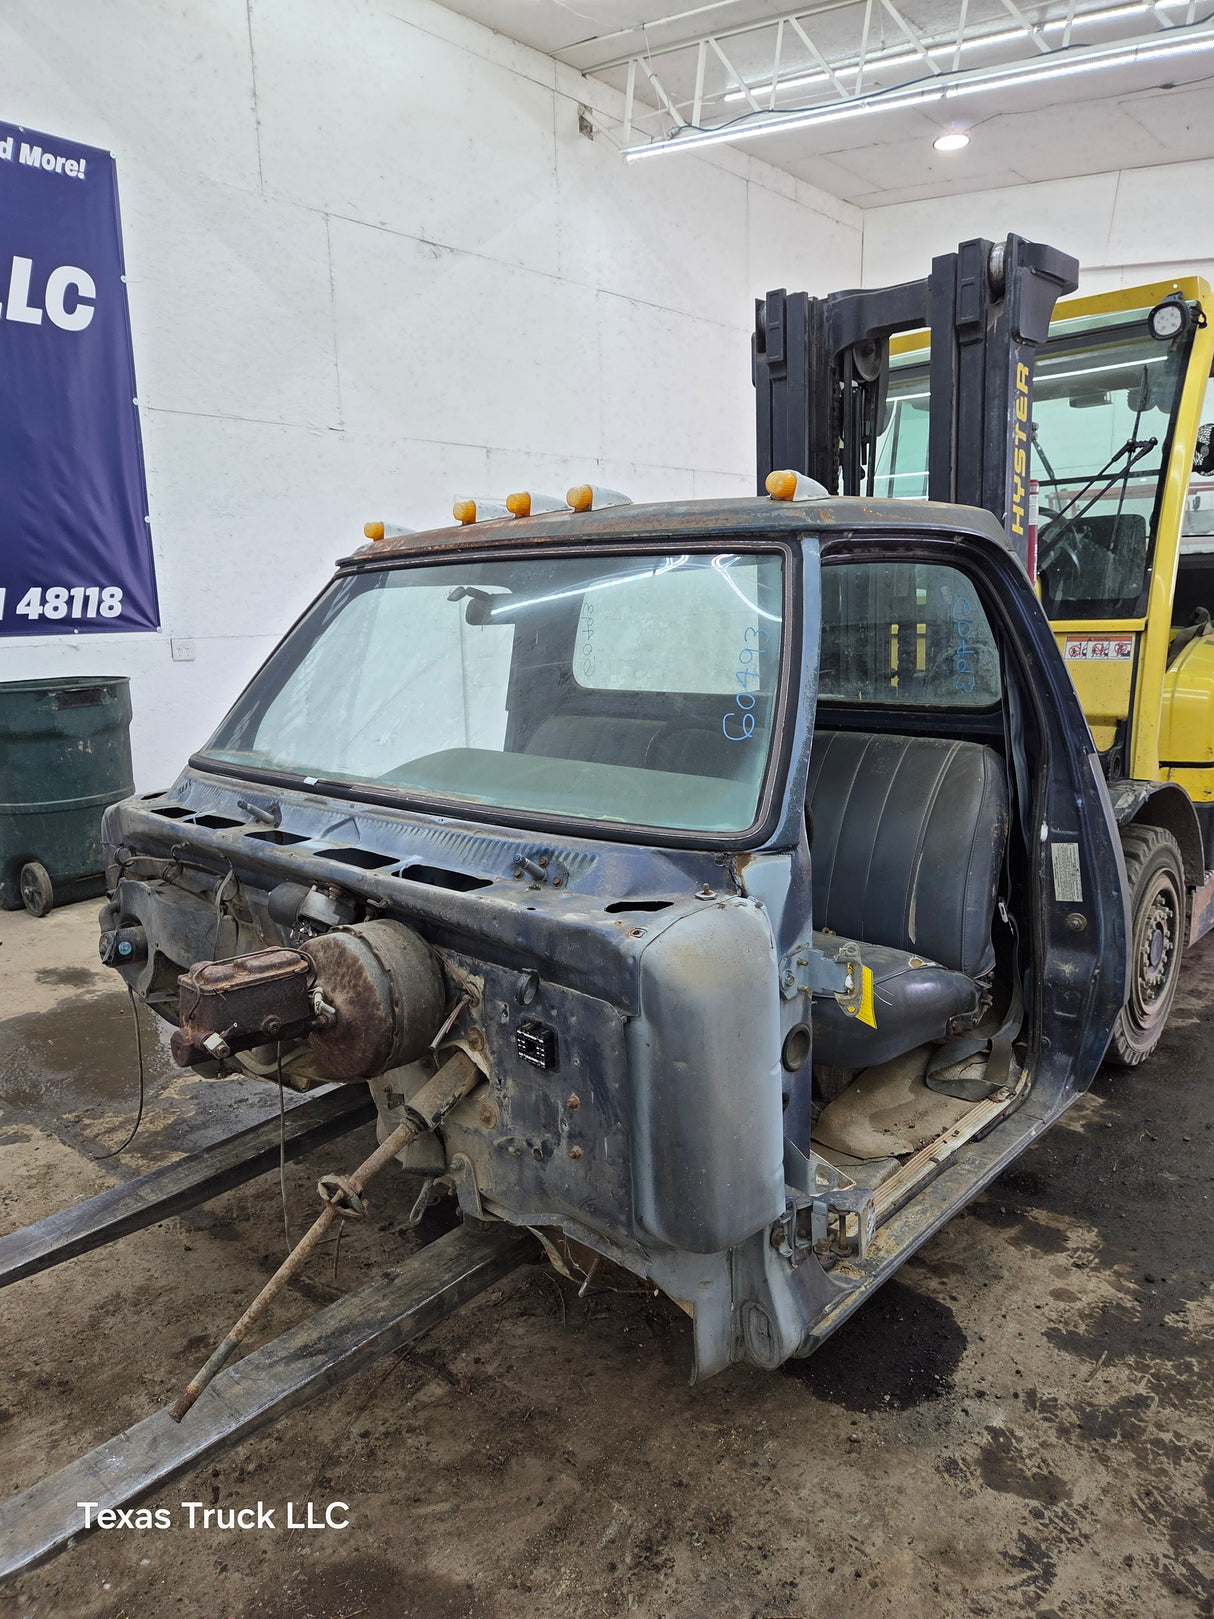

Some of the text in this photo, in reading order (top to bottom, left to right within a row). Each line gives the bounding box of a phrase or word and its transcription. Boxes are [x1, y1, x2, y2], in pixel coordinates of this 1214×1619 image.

[19, 142, 86, 179] More!
[0, 255, 97, 332] LC
[1012, 362, 1029, 535] HYSTER
[16, 586, 123, 620] 48118
[722, 626, 770, 740] 60493
